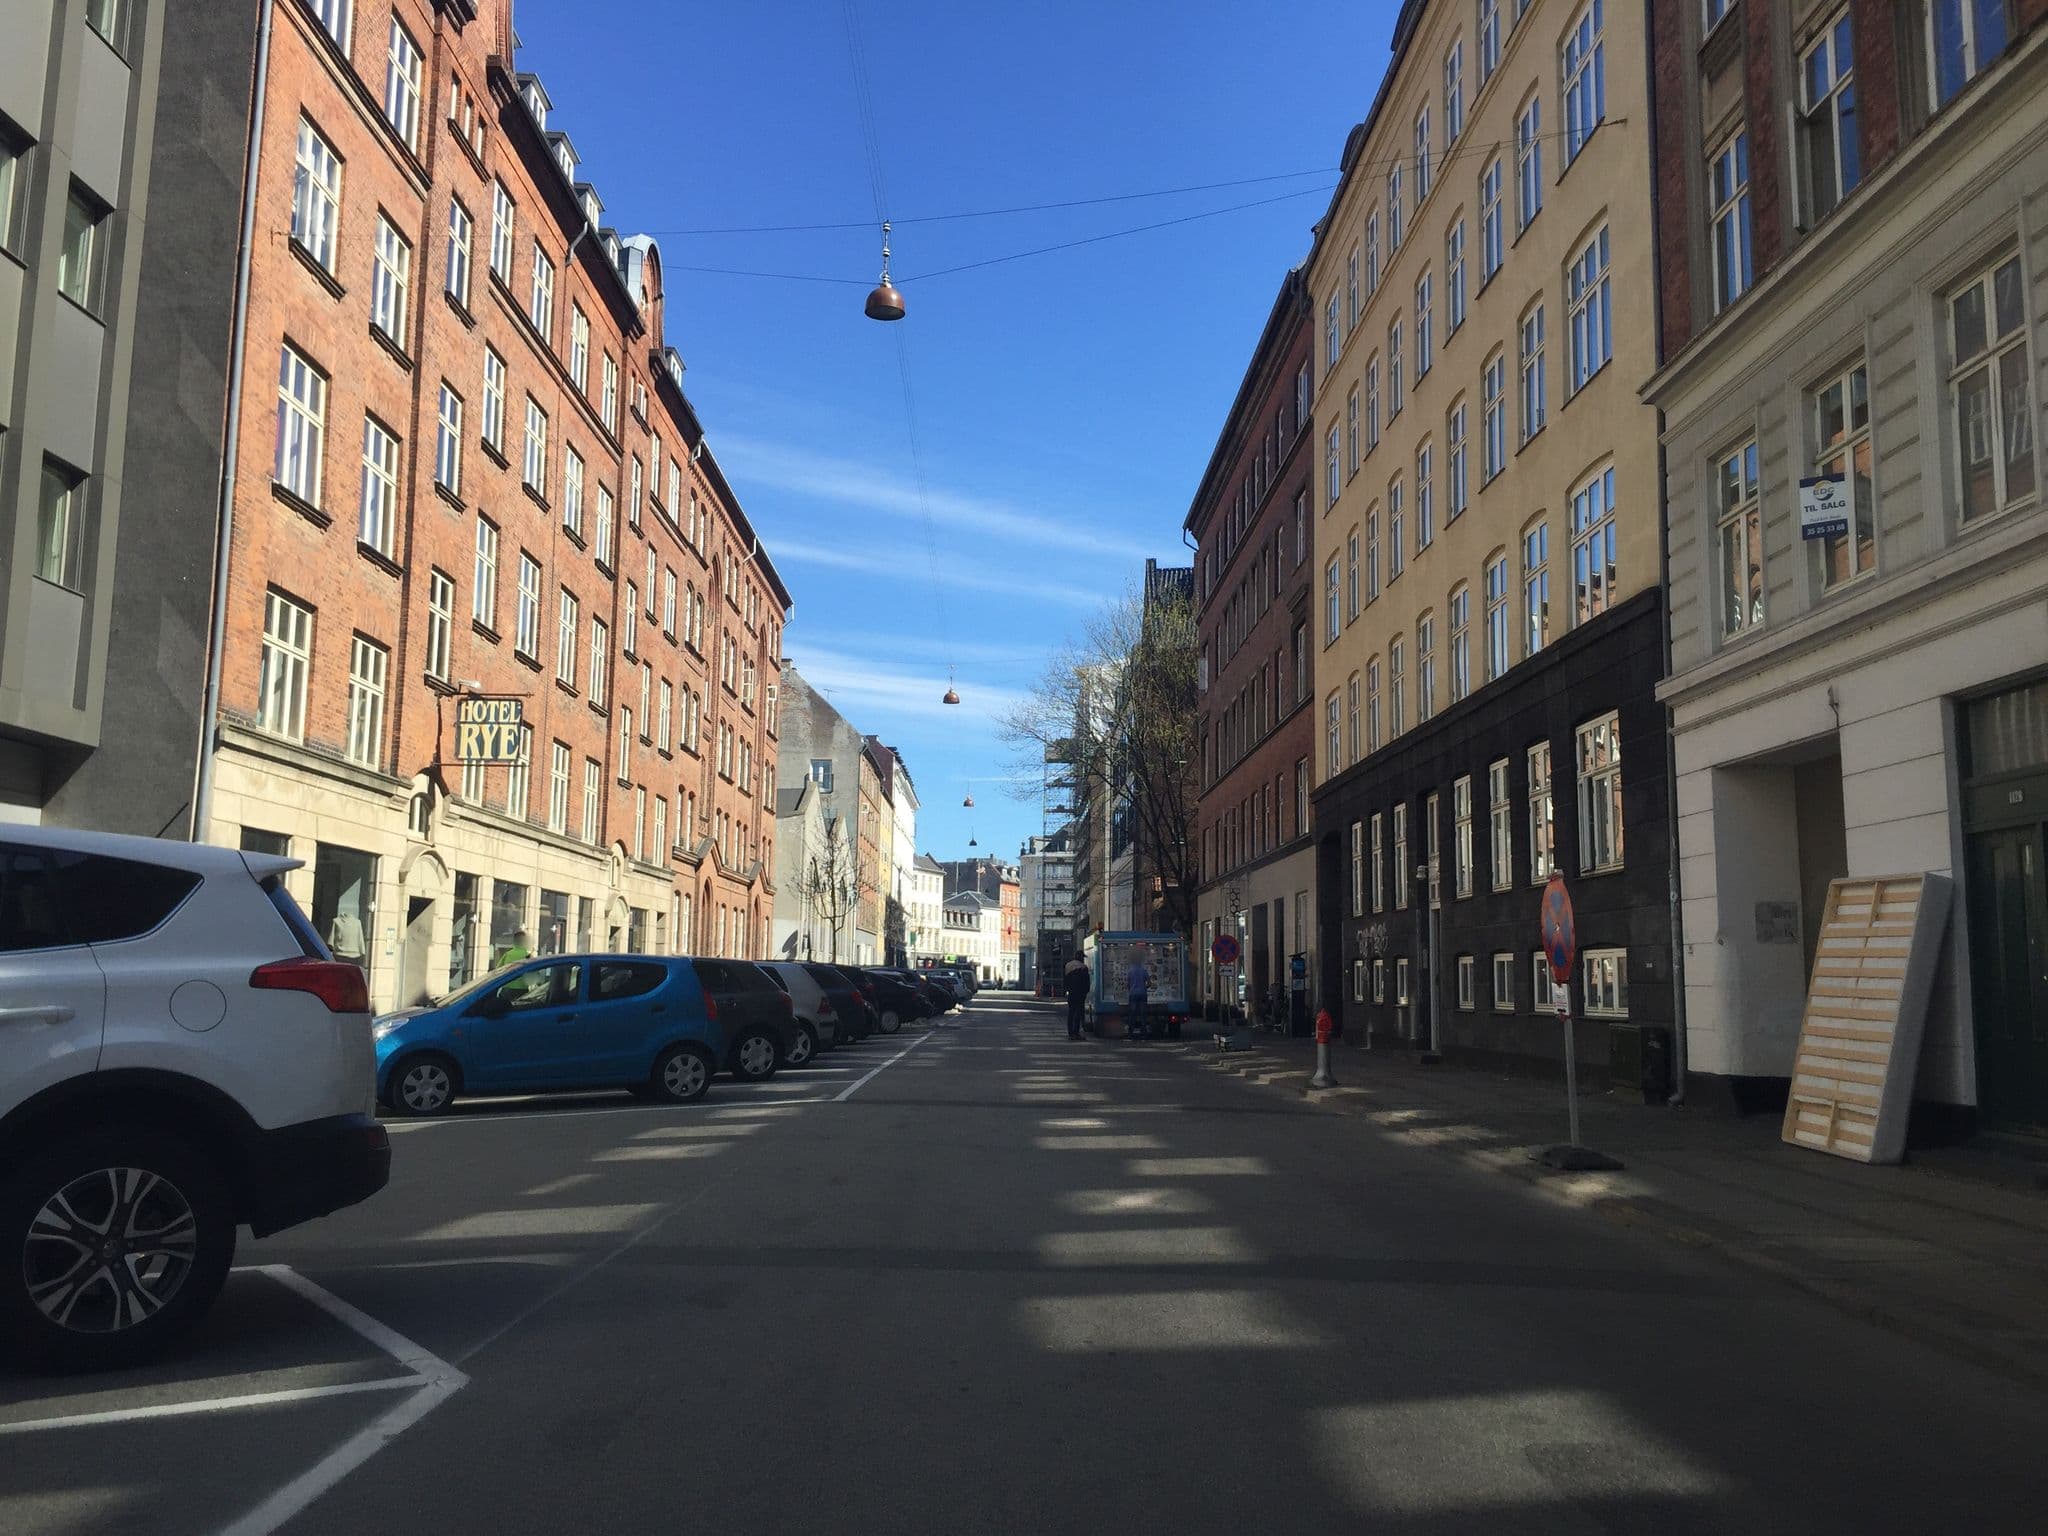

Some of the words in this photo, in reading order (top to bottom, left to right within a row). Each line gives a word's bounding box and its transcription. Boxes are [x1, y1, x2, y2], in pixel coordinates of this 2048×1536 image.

[1813, 487, 1835, 496] EDC
[1804, 504, 1818, 512] TIL
[1821, 500, 1846, 510] SALG
[460, 700, 521, 722] HOTEL
[458, 723, 519, 760] RYE
